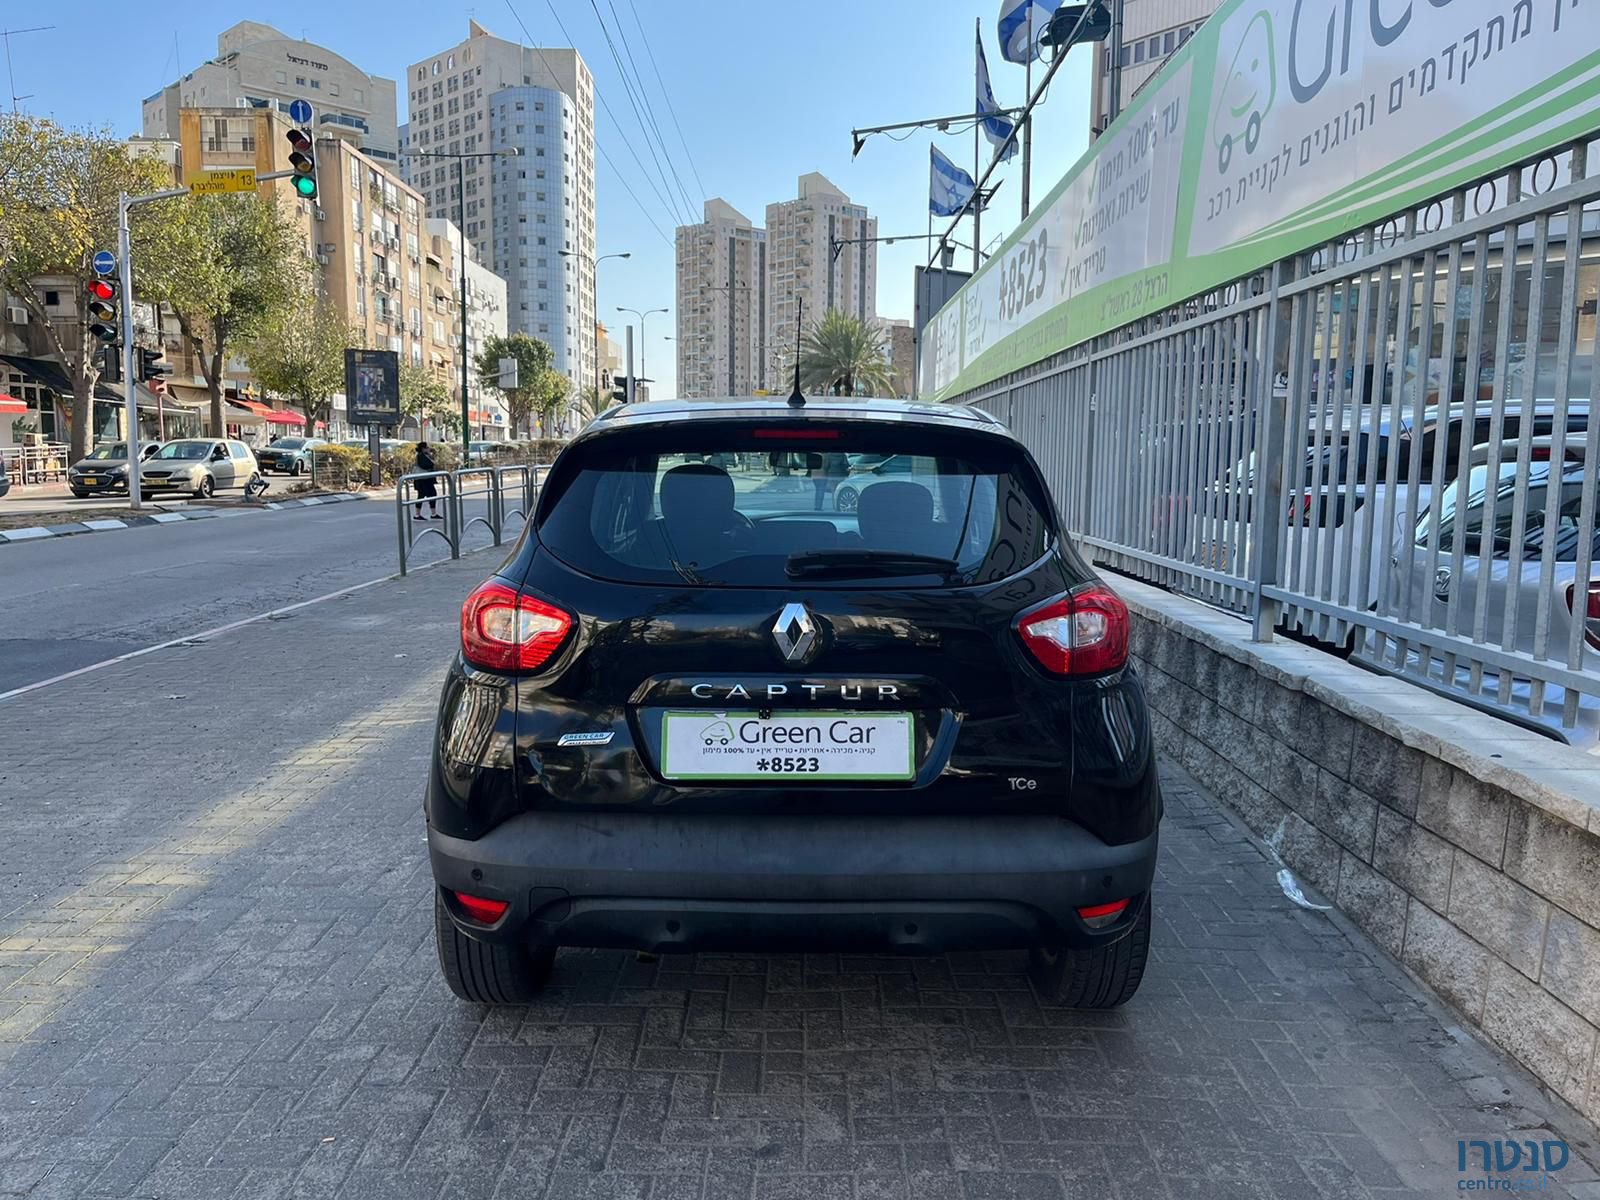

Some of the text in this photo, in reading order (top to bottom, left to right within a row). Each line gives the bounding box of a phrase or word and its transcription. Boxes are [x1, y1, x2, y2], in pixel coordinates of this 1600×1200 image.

[1388, 0, 1533, 114] מתקדמים
[1299, 93, 1376, 167] והוגנים
[1098, 96, 1180, 203] עד 100% מימון
[209, 171, 230, 182] ויצמן
[240, 174, 253, 186] 13
[1236, 143, 1292, 205] לקניית
[1081, 168, 1151, 248] שירות ואמינות
[1207, 186, 1231, 221] רכב
[1068, 245, 1106, 299] טרייד אין
[690, 684, 901, 700] CAPTUR
[739, 720, 876, 744] Green Car
[703, 747, 722, 755] מימון
[761, 747, 771, 755] אין
[859, 747, 876, 755] קניה
[1007, 776, 1037, 790] TCe
